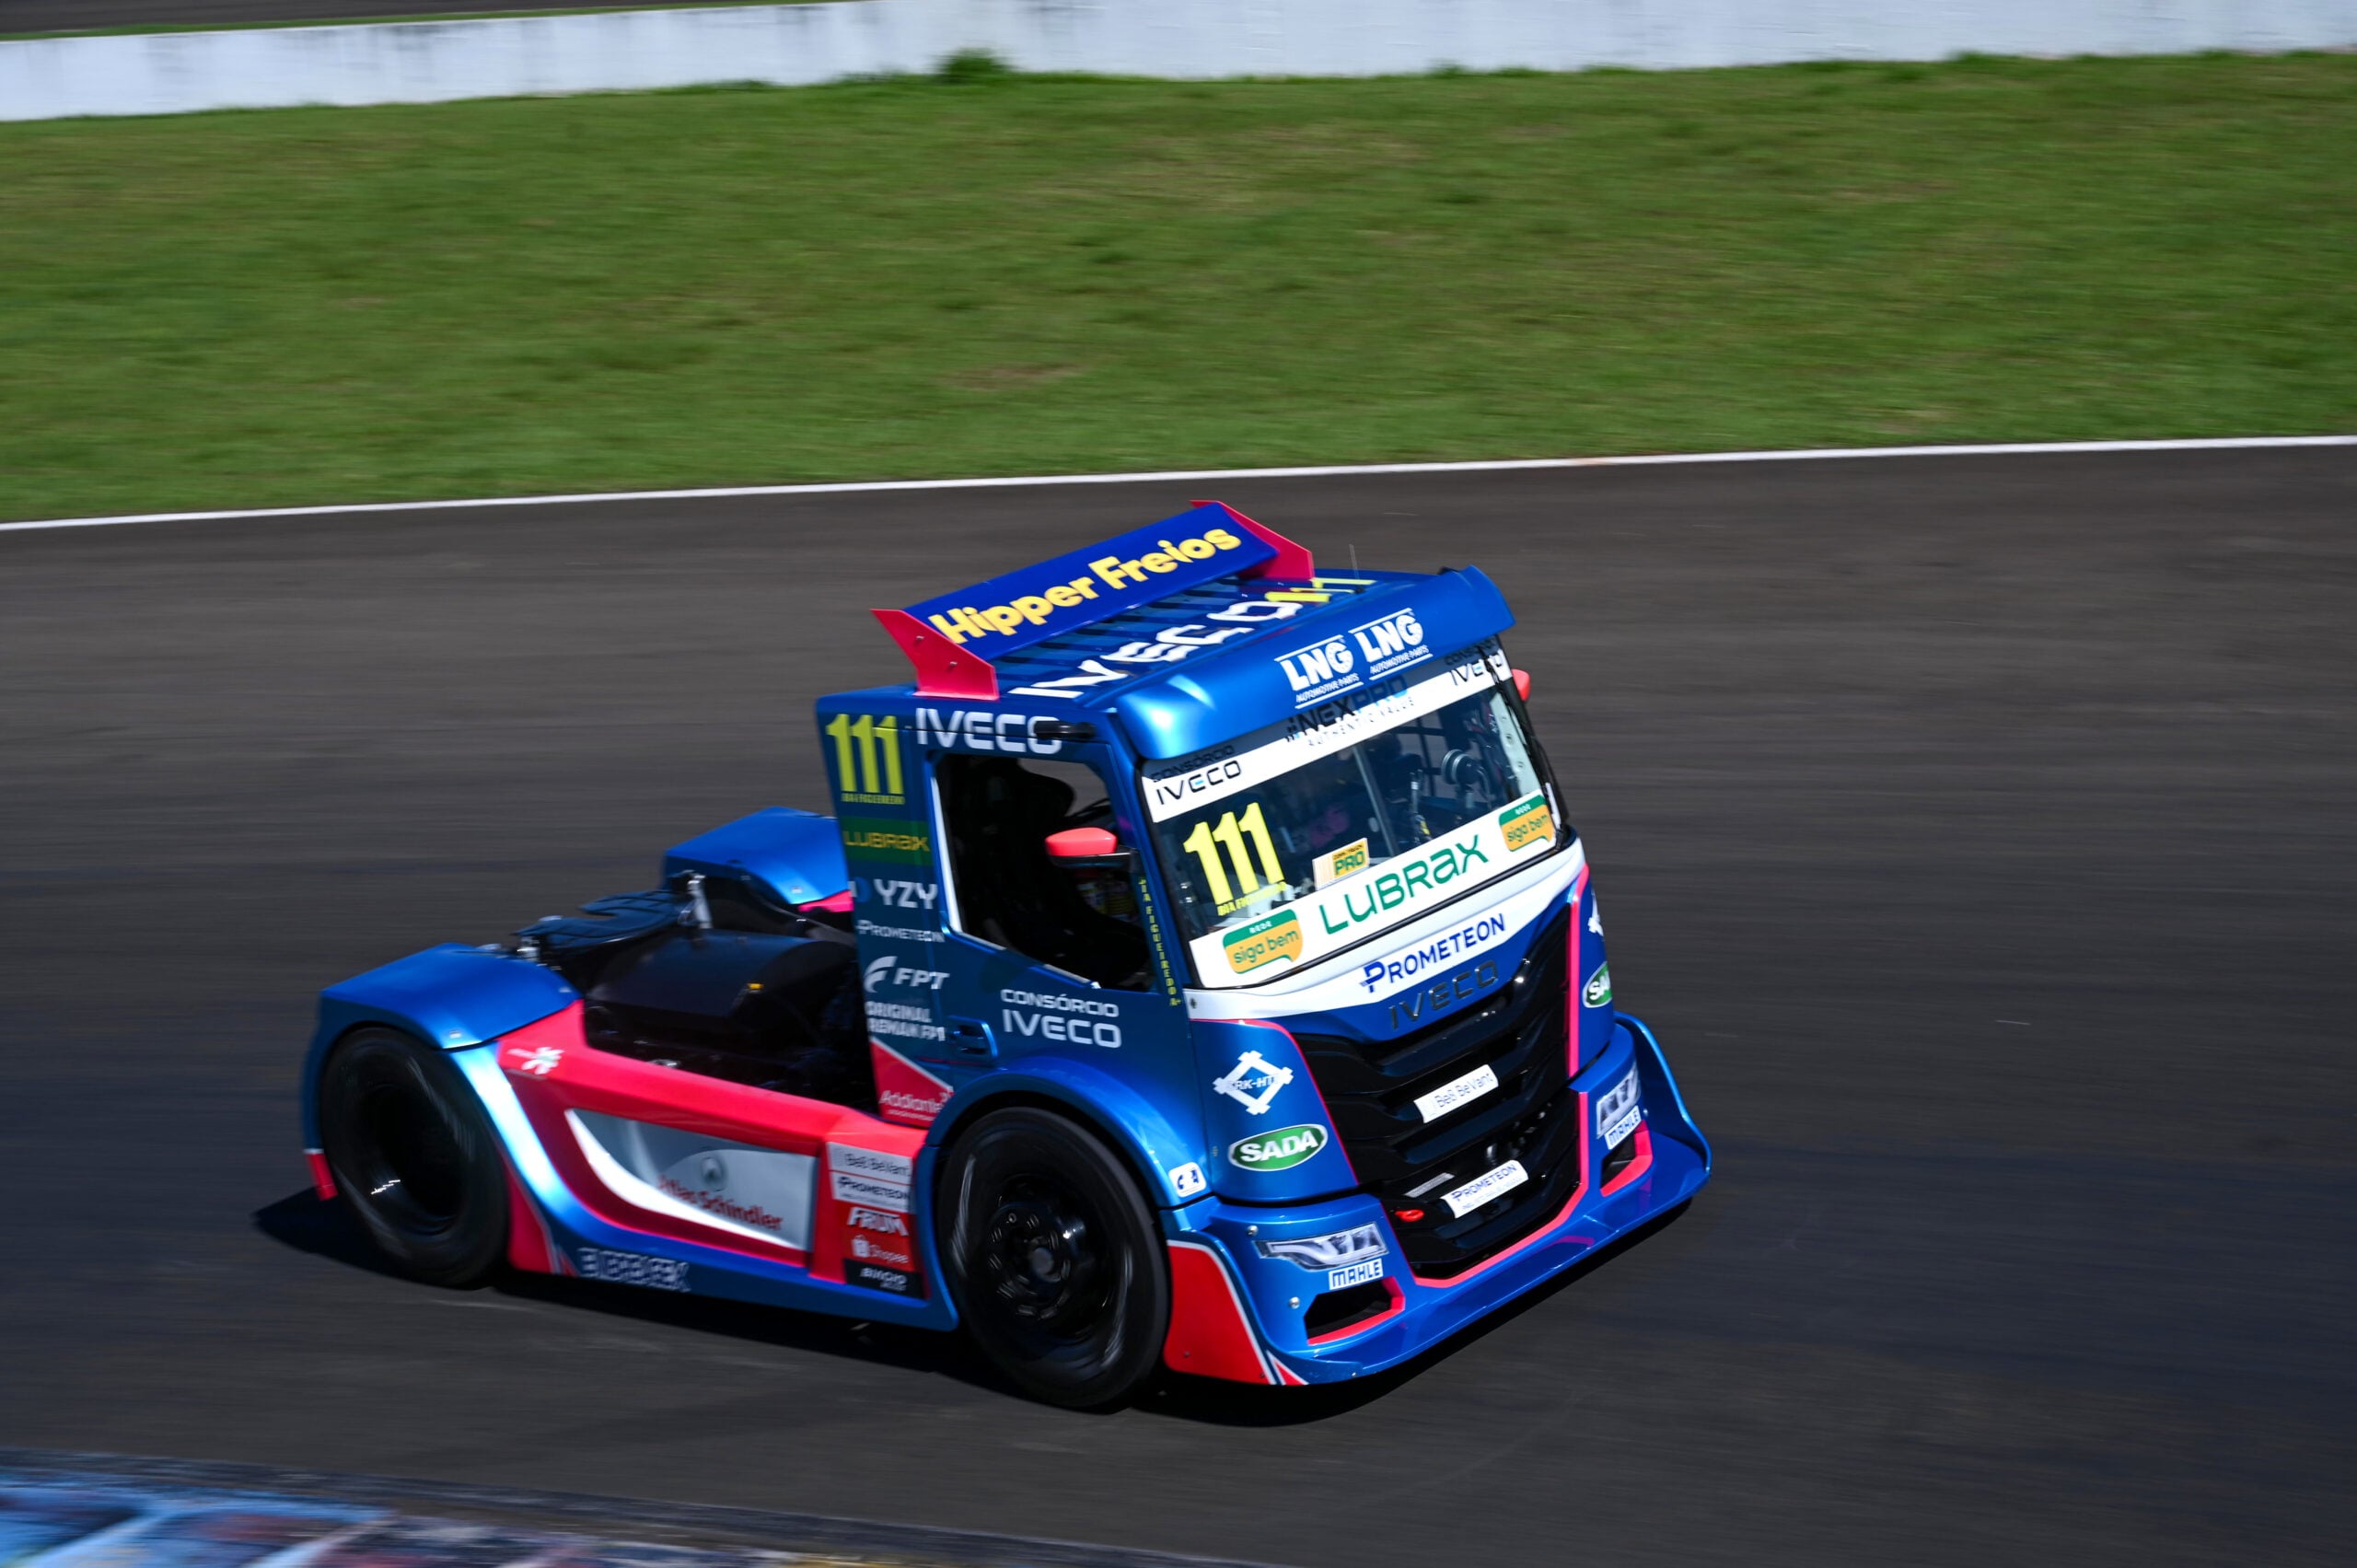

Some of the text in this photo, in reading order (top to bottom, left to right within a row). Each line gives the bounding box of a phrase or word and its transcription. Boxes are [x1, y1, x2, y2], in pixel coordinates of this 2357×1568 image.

[929, 528, 1242, 644] Hipper Freios
[1007, 601, 1303, 698] IVECO
[1353, 614, 1423, 663] LNG
[1280, 642, 1353, 691] LNG
[915, 707, 1062, 754] IVECO
[826, 714, 904, 795] 111
[1156, 760, 1241, 805] IVECO
[1183, 802, 1284, 905] 111
[1334, 851, 1365, 876] PRO
[875, 878, 937, 910] YZY
[856, 920, 945, 943] PROMETEON
[1233, 929, 1300, 964] siga bem
[1360, 912, 1506, 994] PROMETEON
[892, 967, 950, 991] FPT
[1388, 959, 1499, 1029] IVECO
[1000, 988, 1120, 1017] CONSÓRCIO
[1002, 1009, 1121, 1049] IVECO
[1239, 1130, 1319, 1164] SADA
[837, 1176, 909, 1201] PROMETEON
[1450, 1163, 1517, 1202] PROMETEON
[698, 1191, 784, 1231] Schindler
[1331, 1260, 1383, 1288] MAHLE
